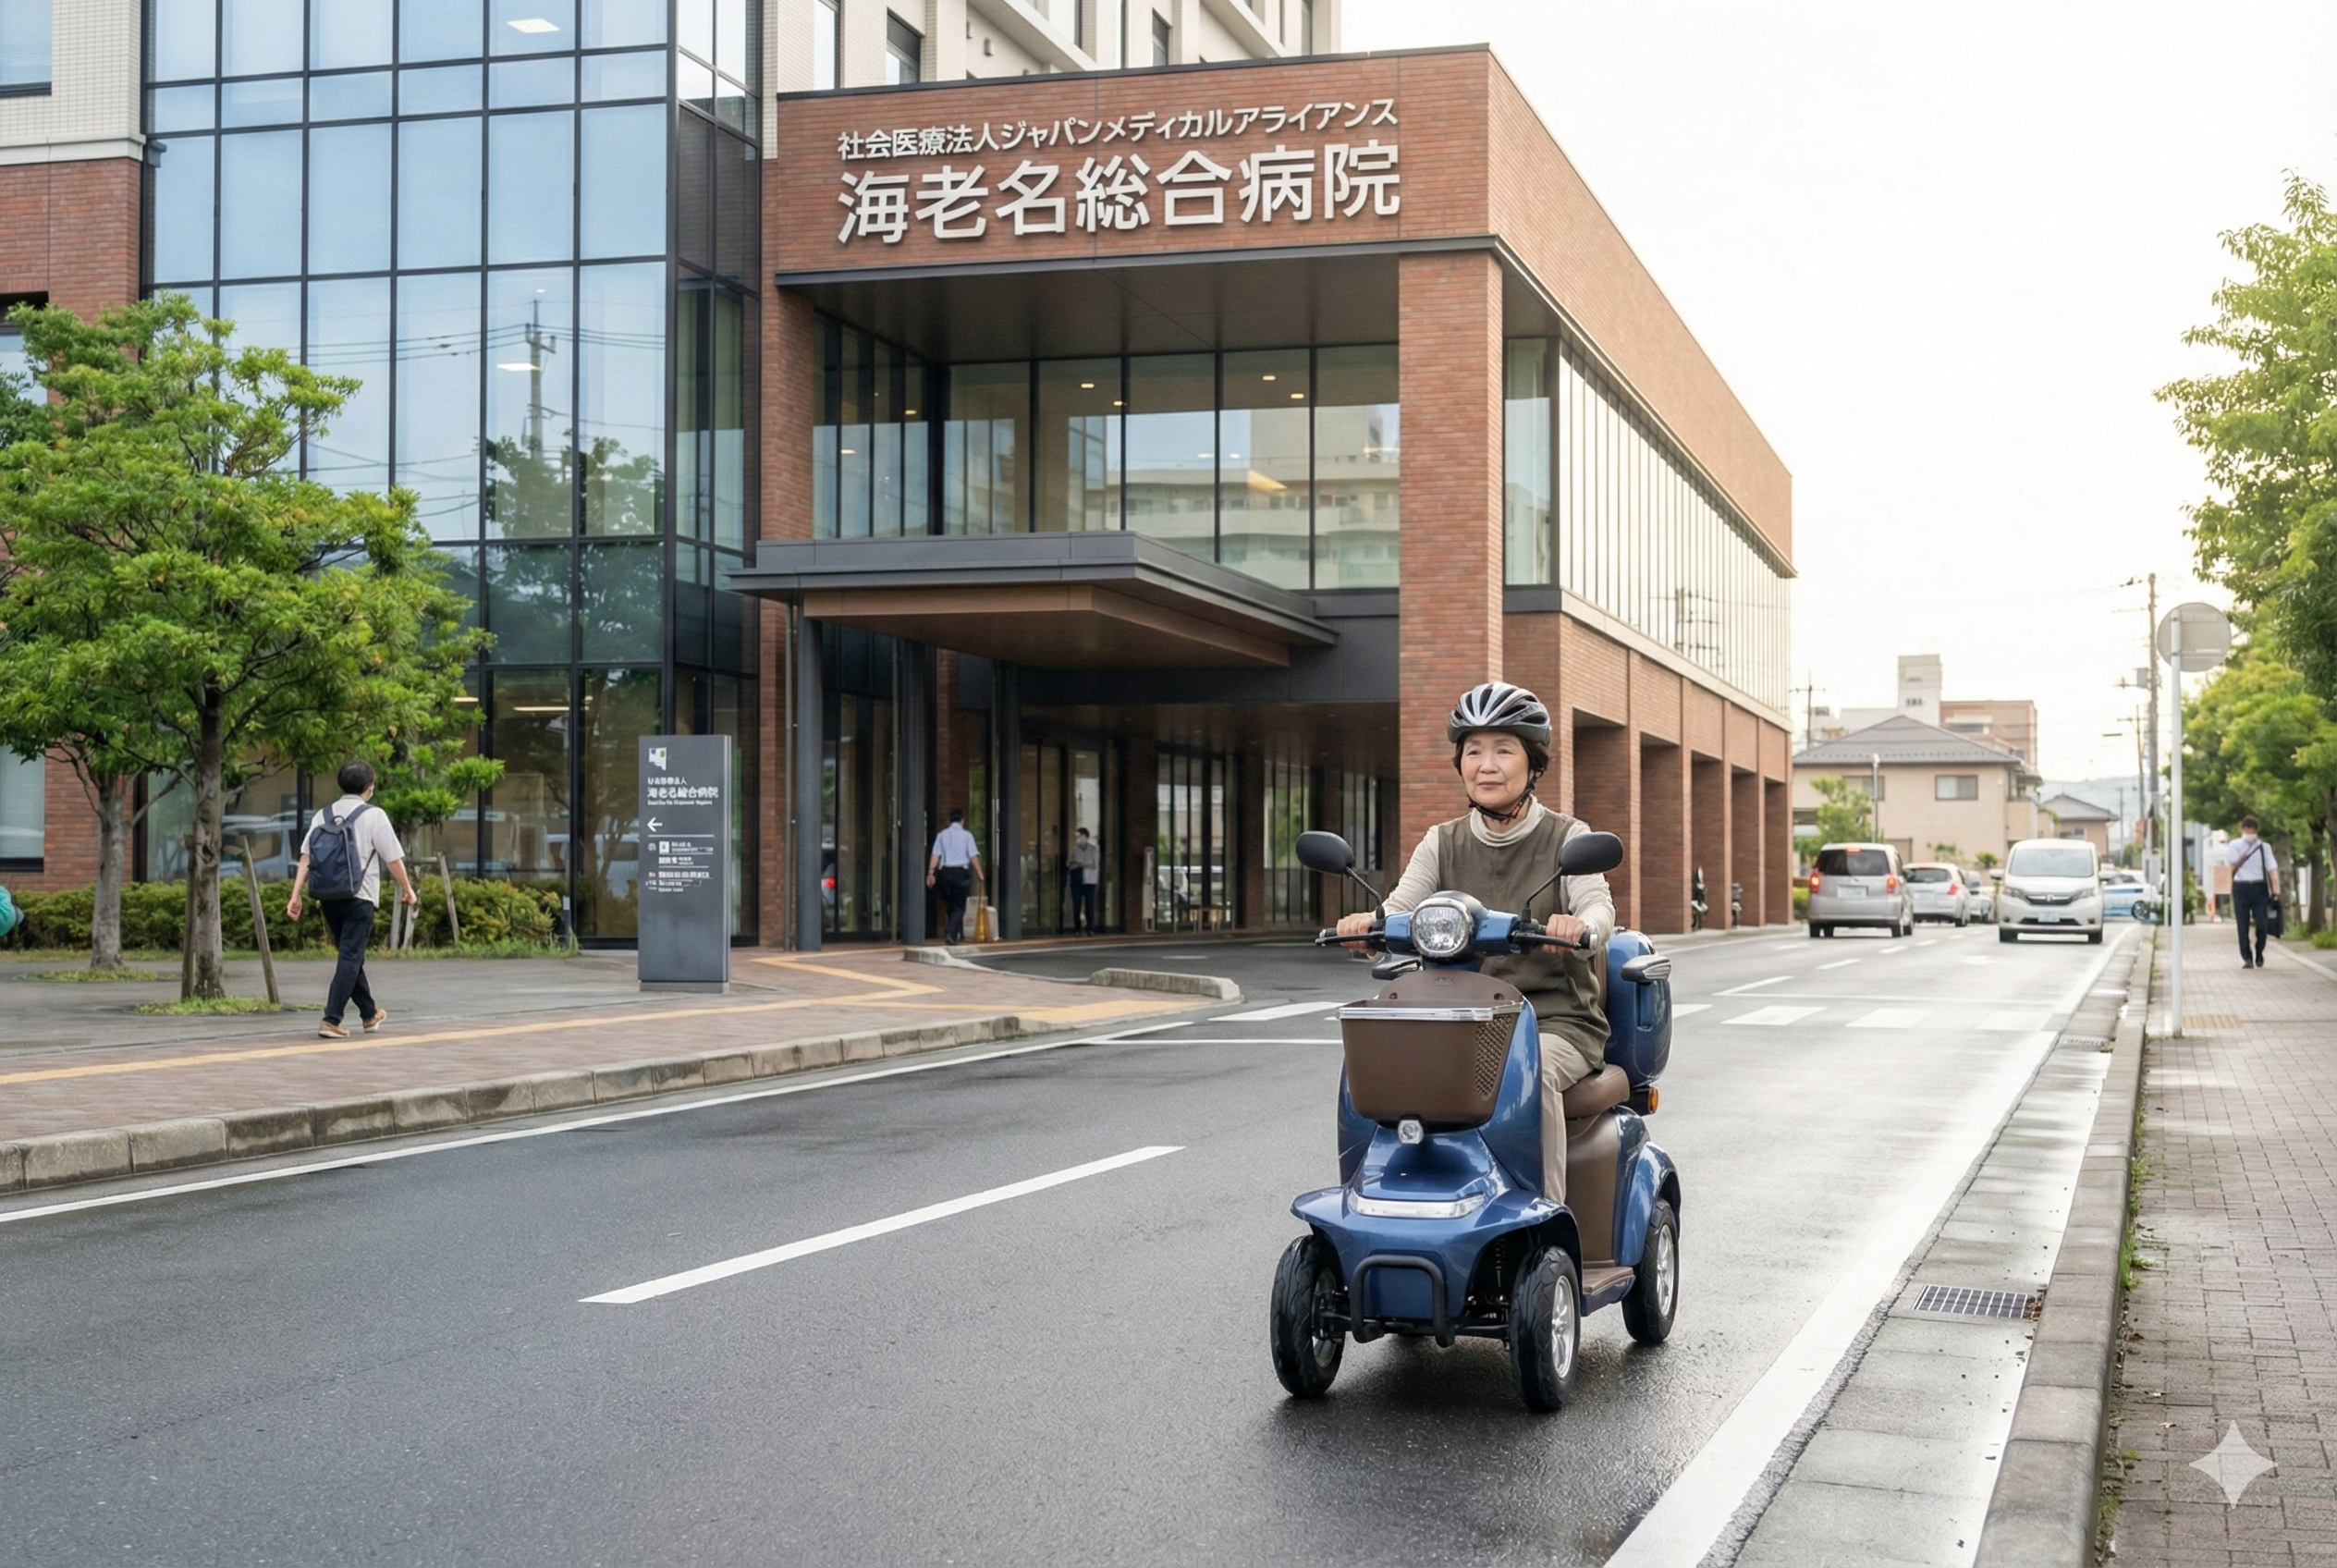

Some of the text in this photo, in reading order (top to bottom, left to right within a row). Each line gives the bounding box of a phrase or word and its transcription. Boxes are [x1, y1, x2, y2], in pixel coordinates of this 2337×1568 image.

[838, 98, 1398, 160] 社会医療法人ジャパンメディカルアライアンス
[838, 140, 1401, 243] 海老名総合病院
